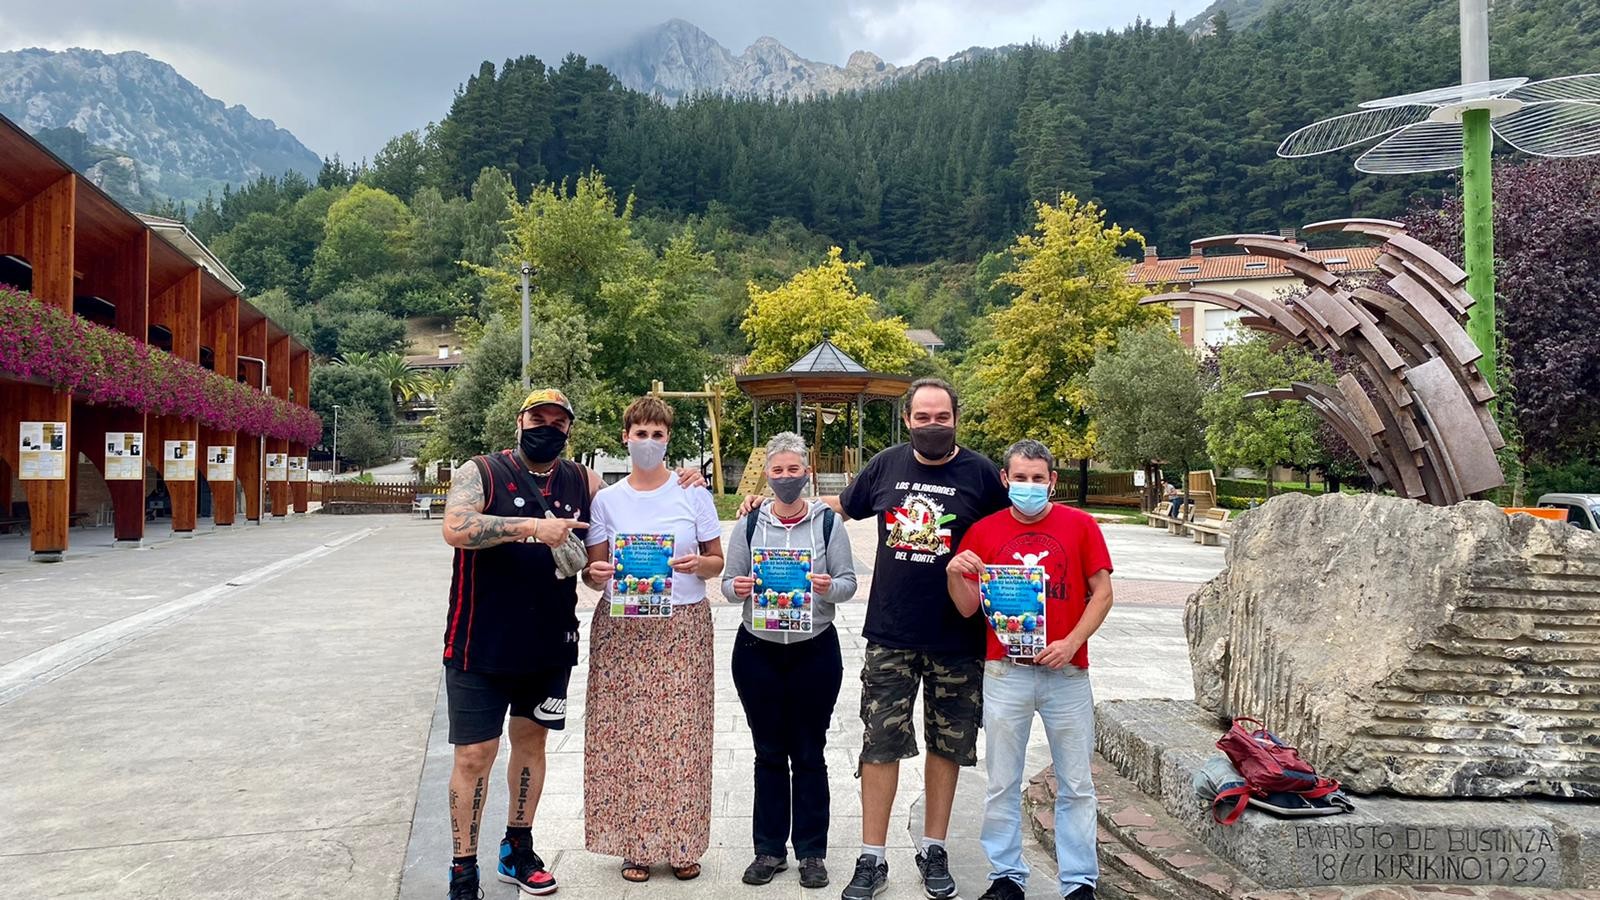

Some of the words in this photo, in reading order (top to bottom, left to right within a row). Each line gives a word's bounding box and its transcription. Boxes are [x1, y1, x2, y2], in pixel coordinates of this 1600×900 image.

[894, 481, 911, 490] LOS
[911, 482, 957, 497] ALAKRANES
[894, 551, 907, 561] DEL
[910, 553, 937, 564] NORTE
[515, 766, 531, 821] AKETZ
[1295, 824, 1395, 850] EVARISTO
[1405, 826, 1437, 851] DE
[1446, 827, 1555, 854] BUSTINZA
